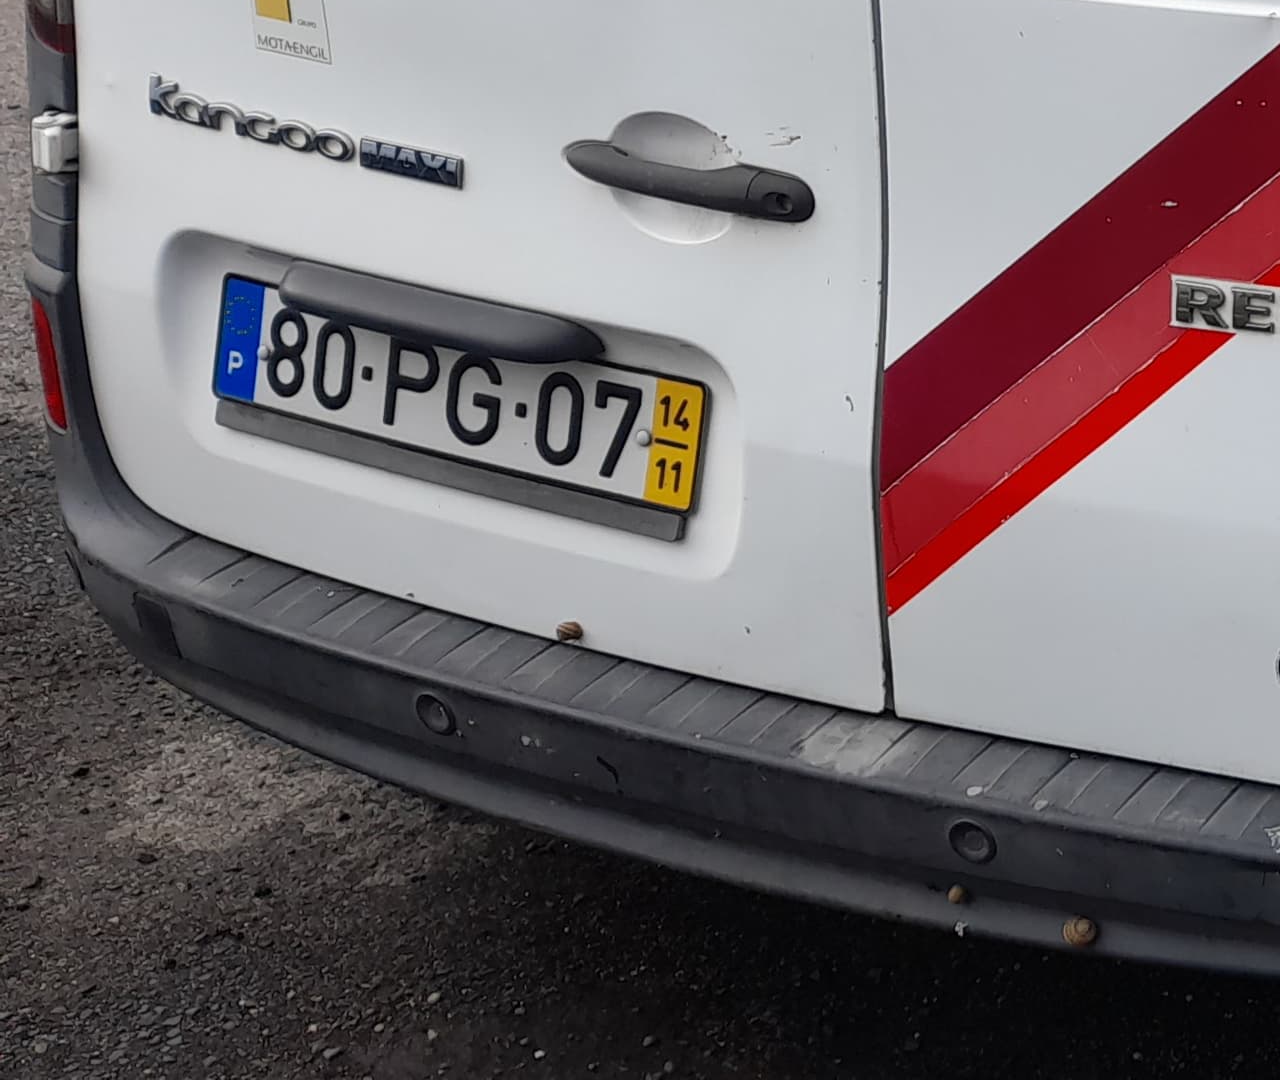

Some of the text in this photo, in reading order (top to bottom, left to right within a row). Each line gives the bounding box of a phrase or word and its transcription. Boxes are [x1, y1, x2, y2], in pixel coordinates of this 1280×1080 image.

[360, 139, 459, 187] MAXI
[226, 349, 244, 375] P
[659, 394, 691, 432] 14
[655, 457, 682, 494] 11
